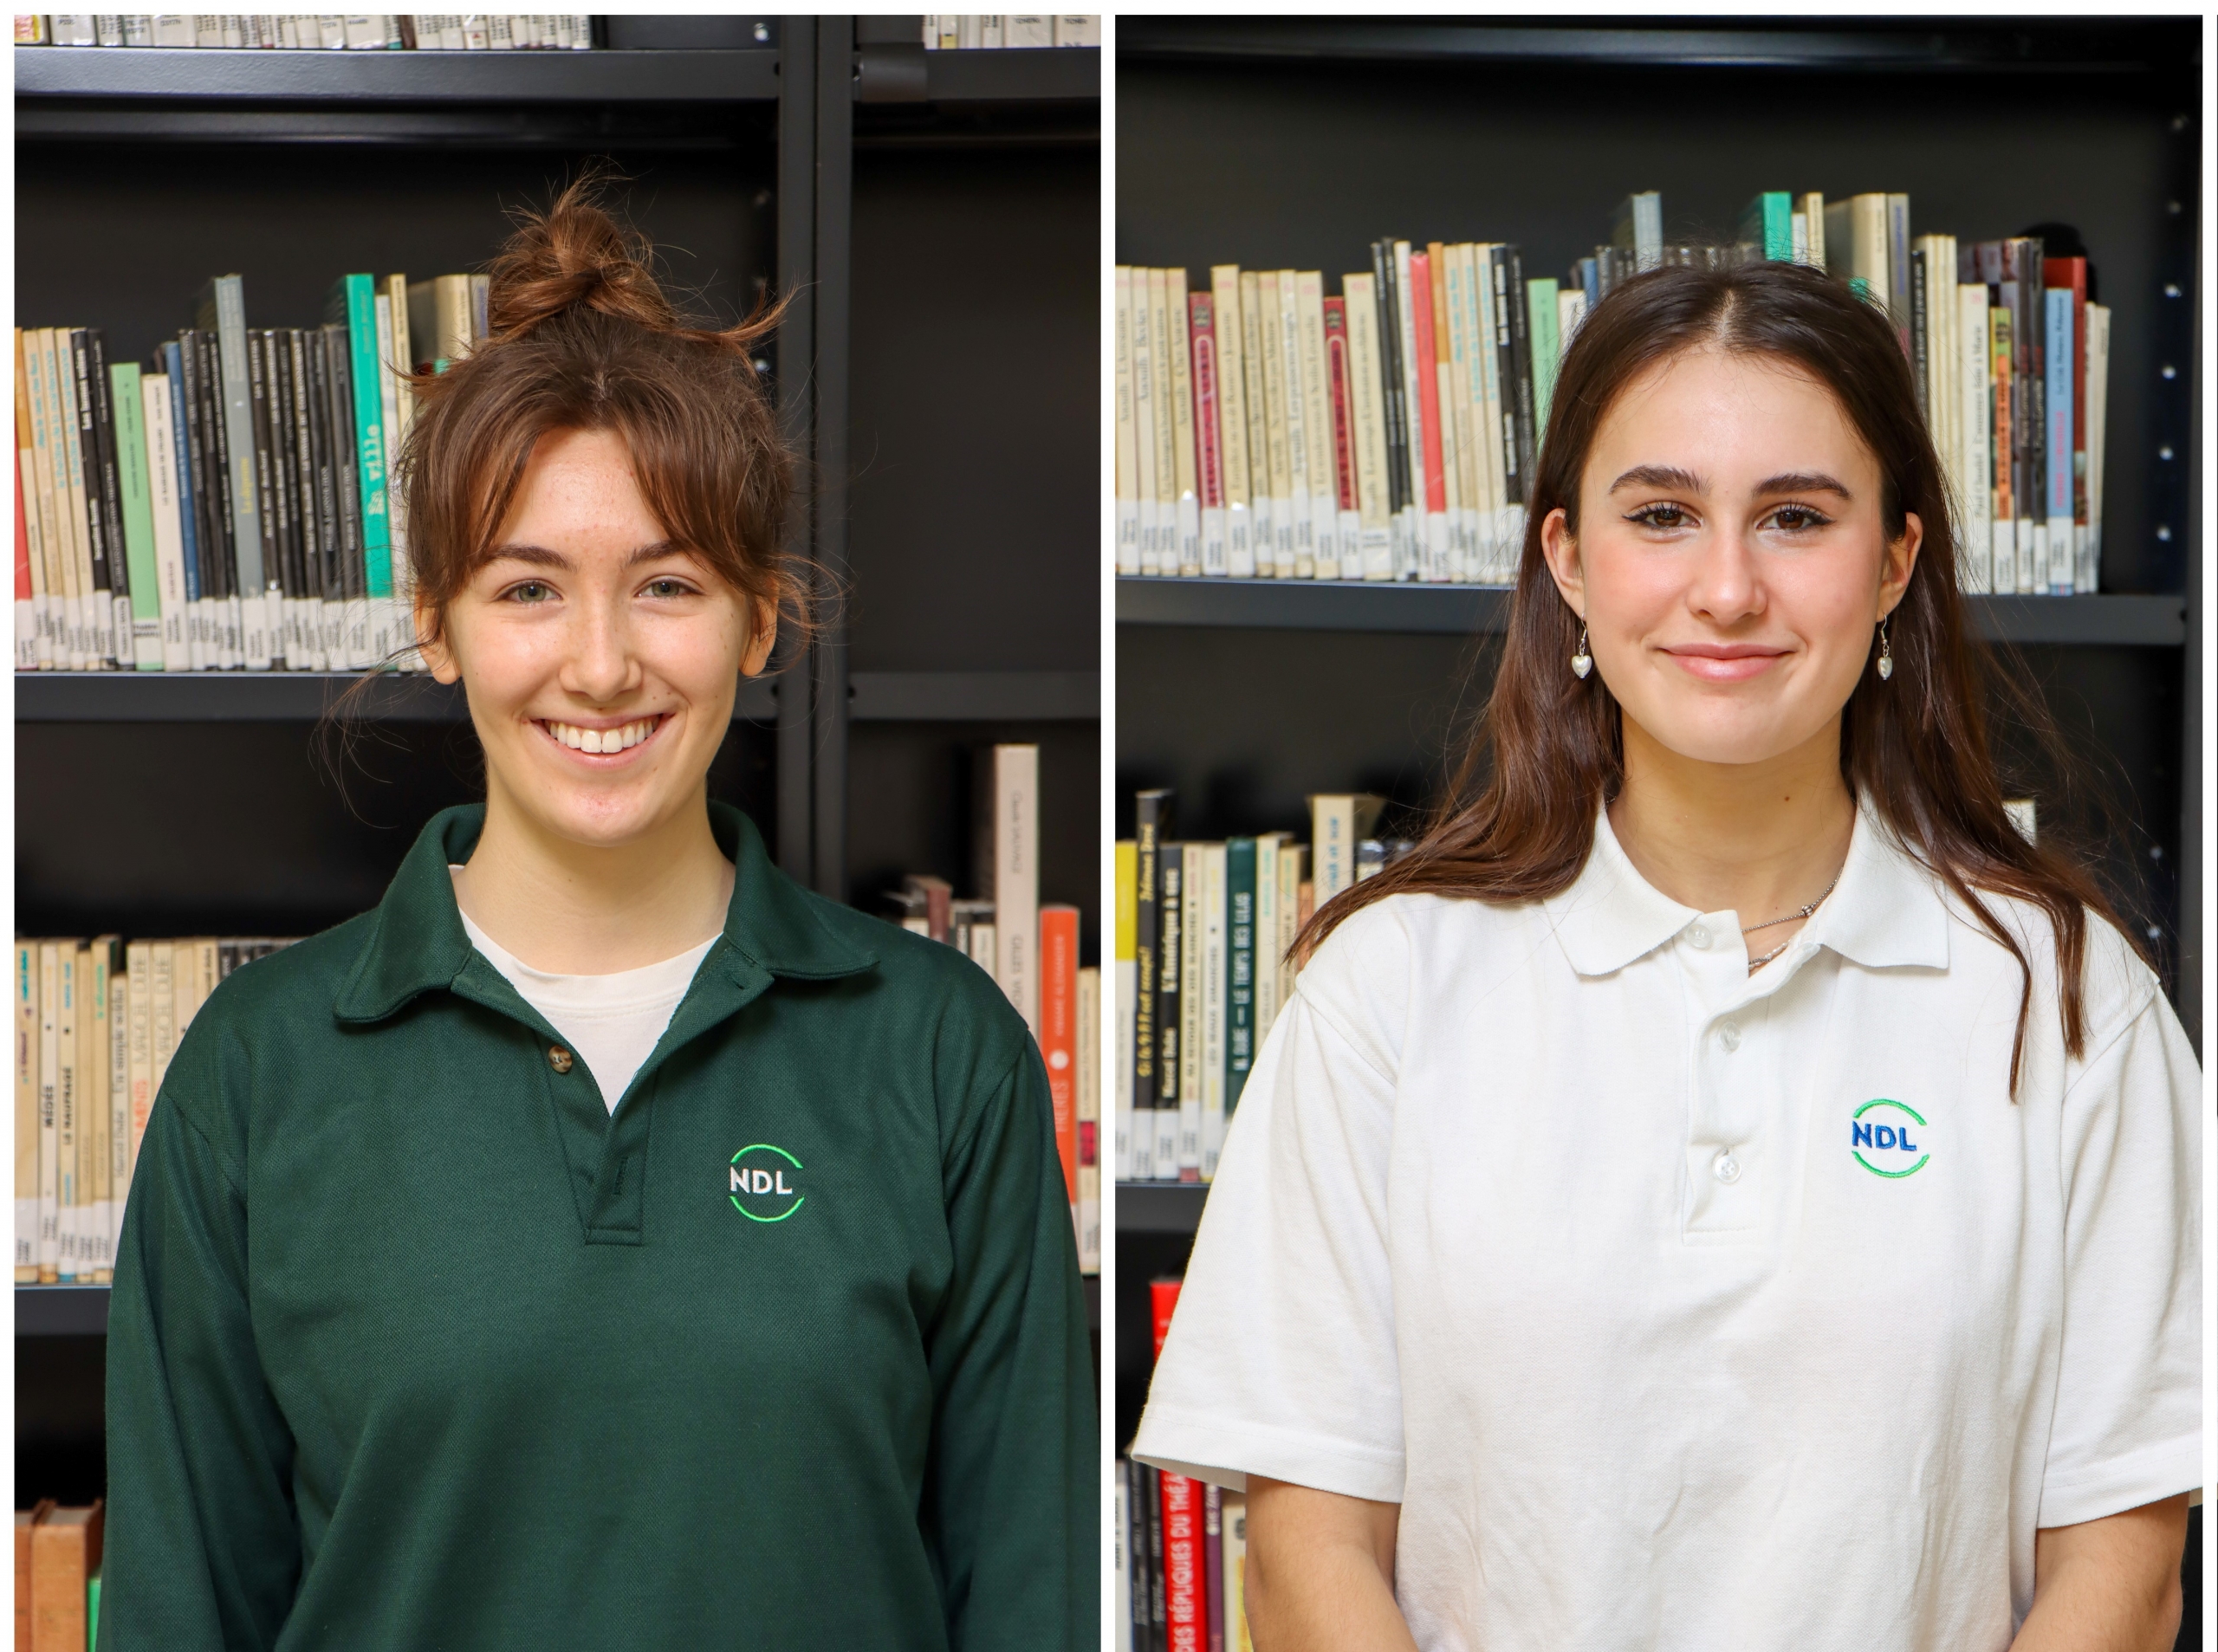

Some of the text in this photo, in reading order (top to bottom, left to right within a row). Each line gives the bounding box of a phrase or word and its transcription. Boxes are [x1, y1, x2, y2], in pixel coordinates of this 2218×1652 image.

[362, 424, 386, 516] En ville
[1161, 869, 1180, 993] L'Amérique à sec
[1235, 925, 1250, 949] DES
[1054, 934, 1066, 997] ALEXANDER
[1234, 951, 1250, 986] TEMPS
[1234, 990, 1249, 1004] LE
[113, 1030, 125, 1072] simple
[131, 1001, 146, 1065] MARCEL
[153, 1002, 170, 1065] MARCEL
[113, 1075, 125, 1094] Un
[1163, 1059, 1177, 1097] Marcel
[1234, 1058, 1249, 1071] M.
[42, 1085, 55, 1129] MÉDÉE
[62, 1066, 73, 1145] LE NAUFRAGÉ
[1852, 1120, 1917, 1151] NDL
[730, 1166, 793, 1195] NDL
[1169, 1514, 1190, 1538] DU
[1166, 1541, 1195, 1623] RÉPLIQUES
